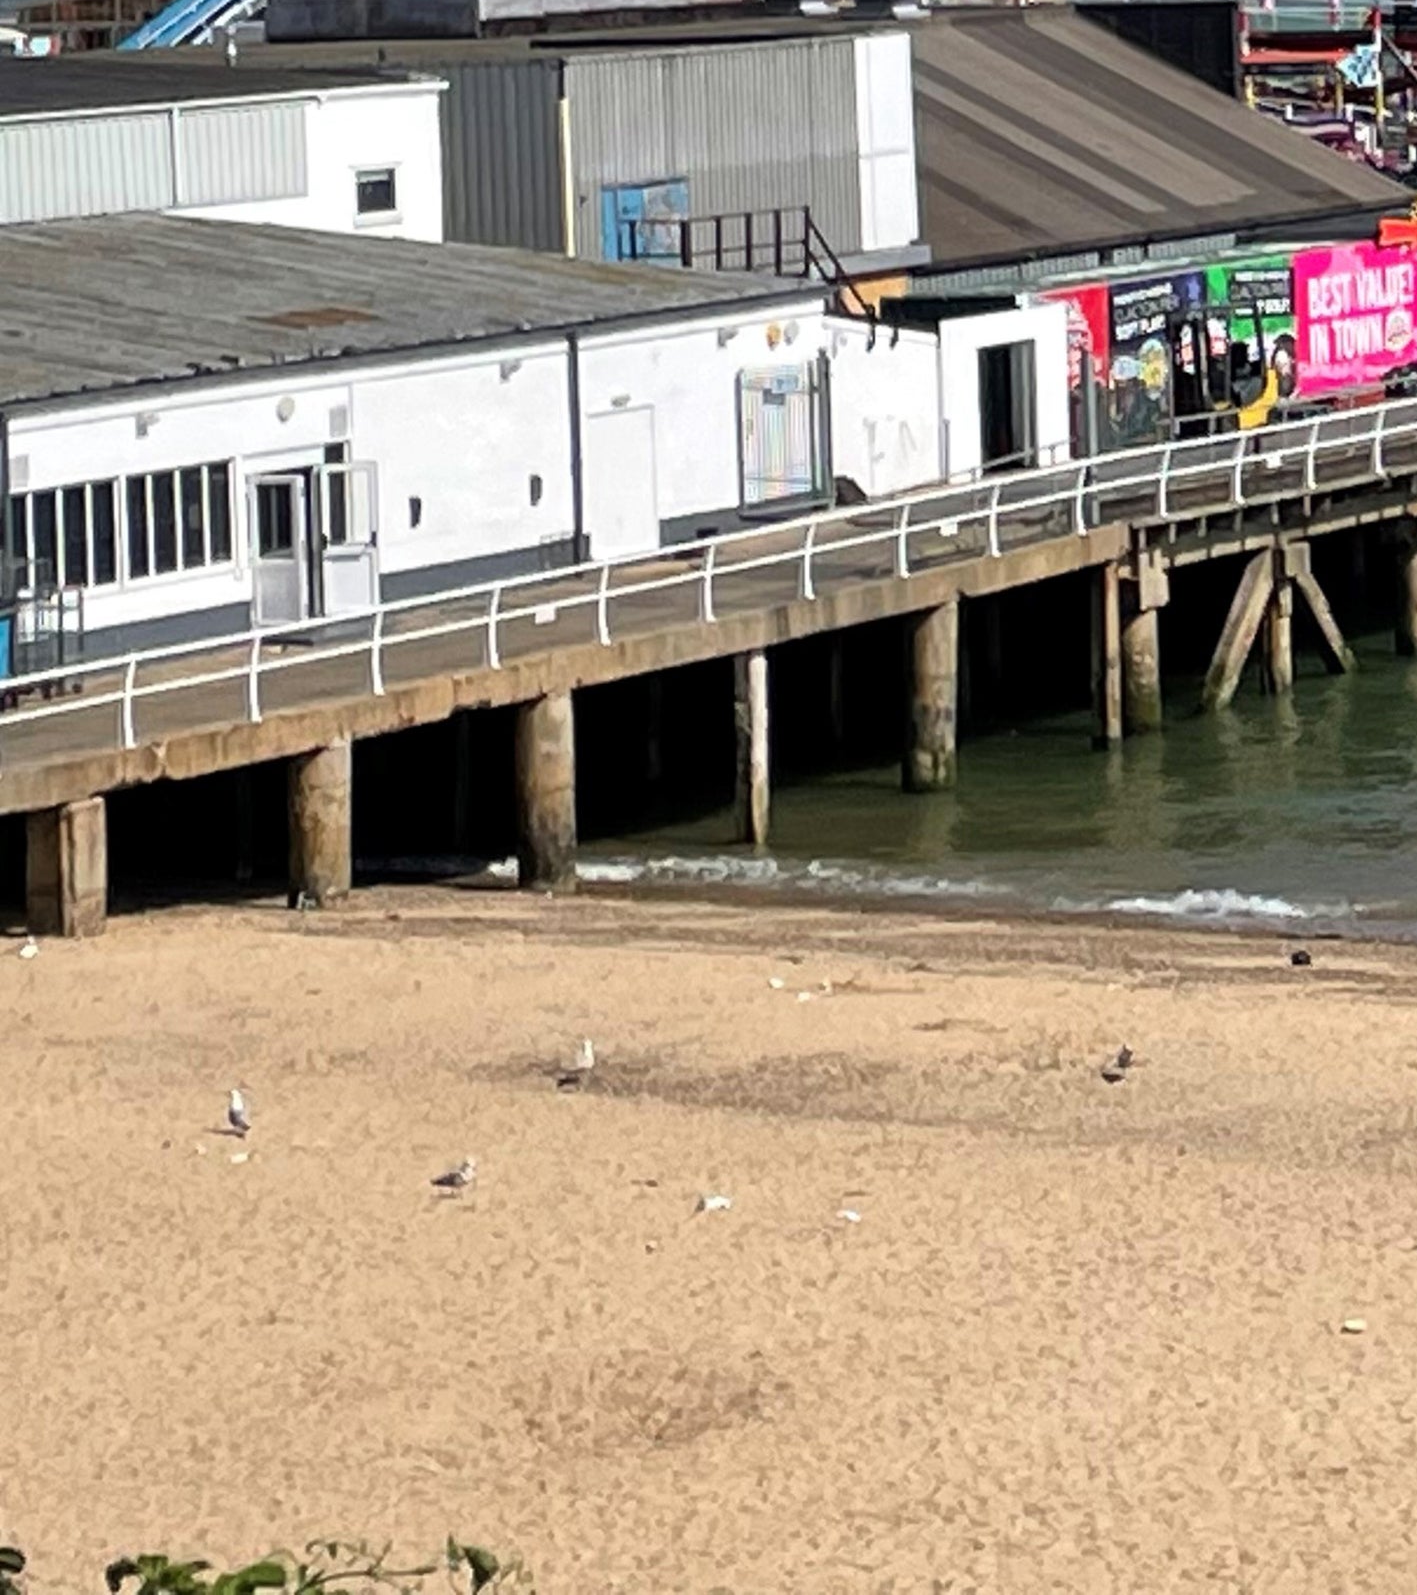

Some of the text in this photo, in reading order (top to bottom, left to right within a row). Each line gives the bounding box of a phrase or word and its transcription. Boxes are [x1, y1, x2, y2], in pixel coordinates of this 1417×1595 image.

[1307, 272, 1351, 319] BEST
[1355, 263, 1414, 310] VALUE!
[1308, 313, 1384, 363] IN TOWN
